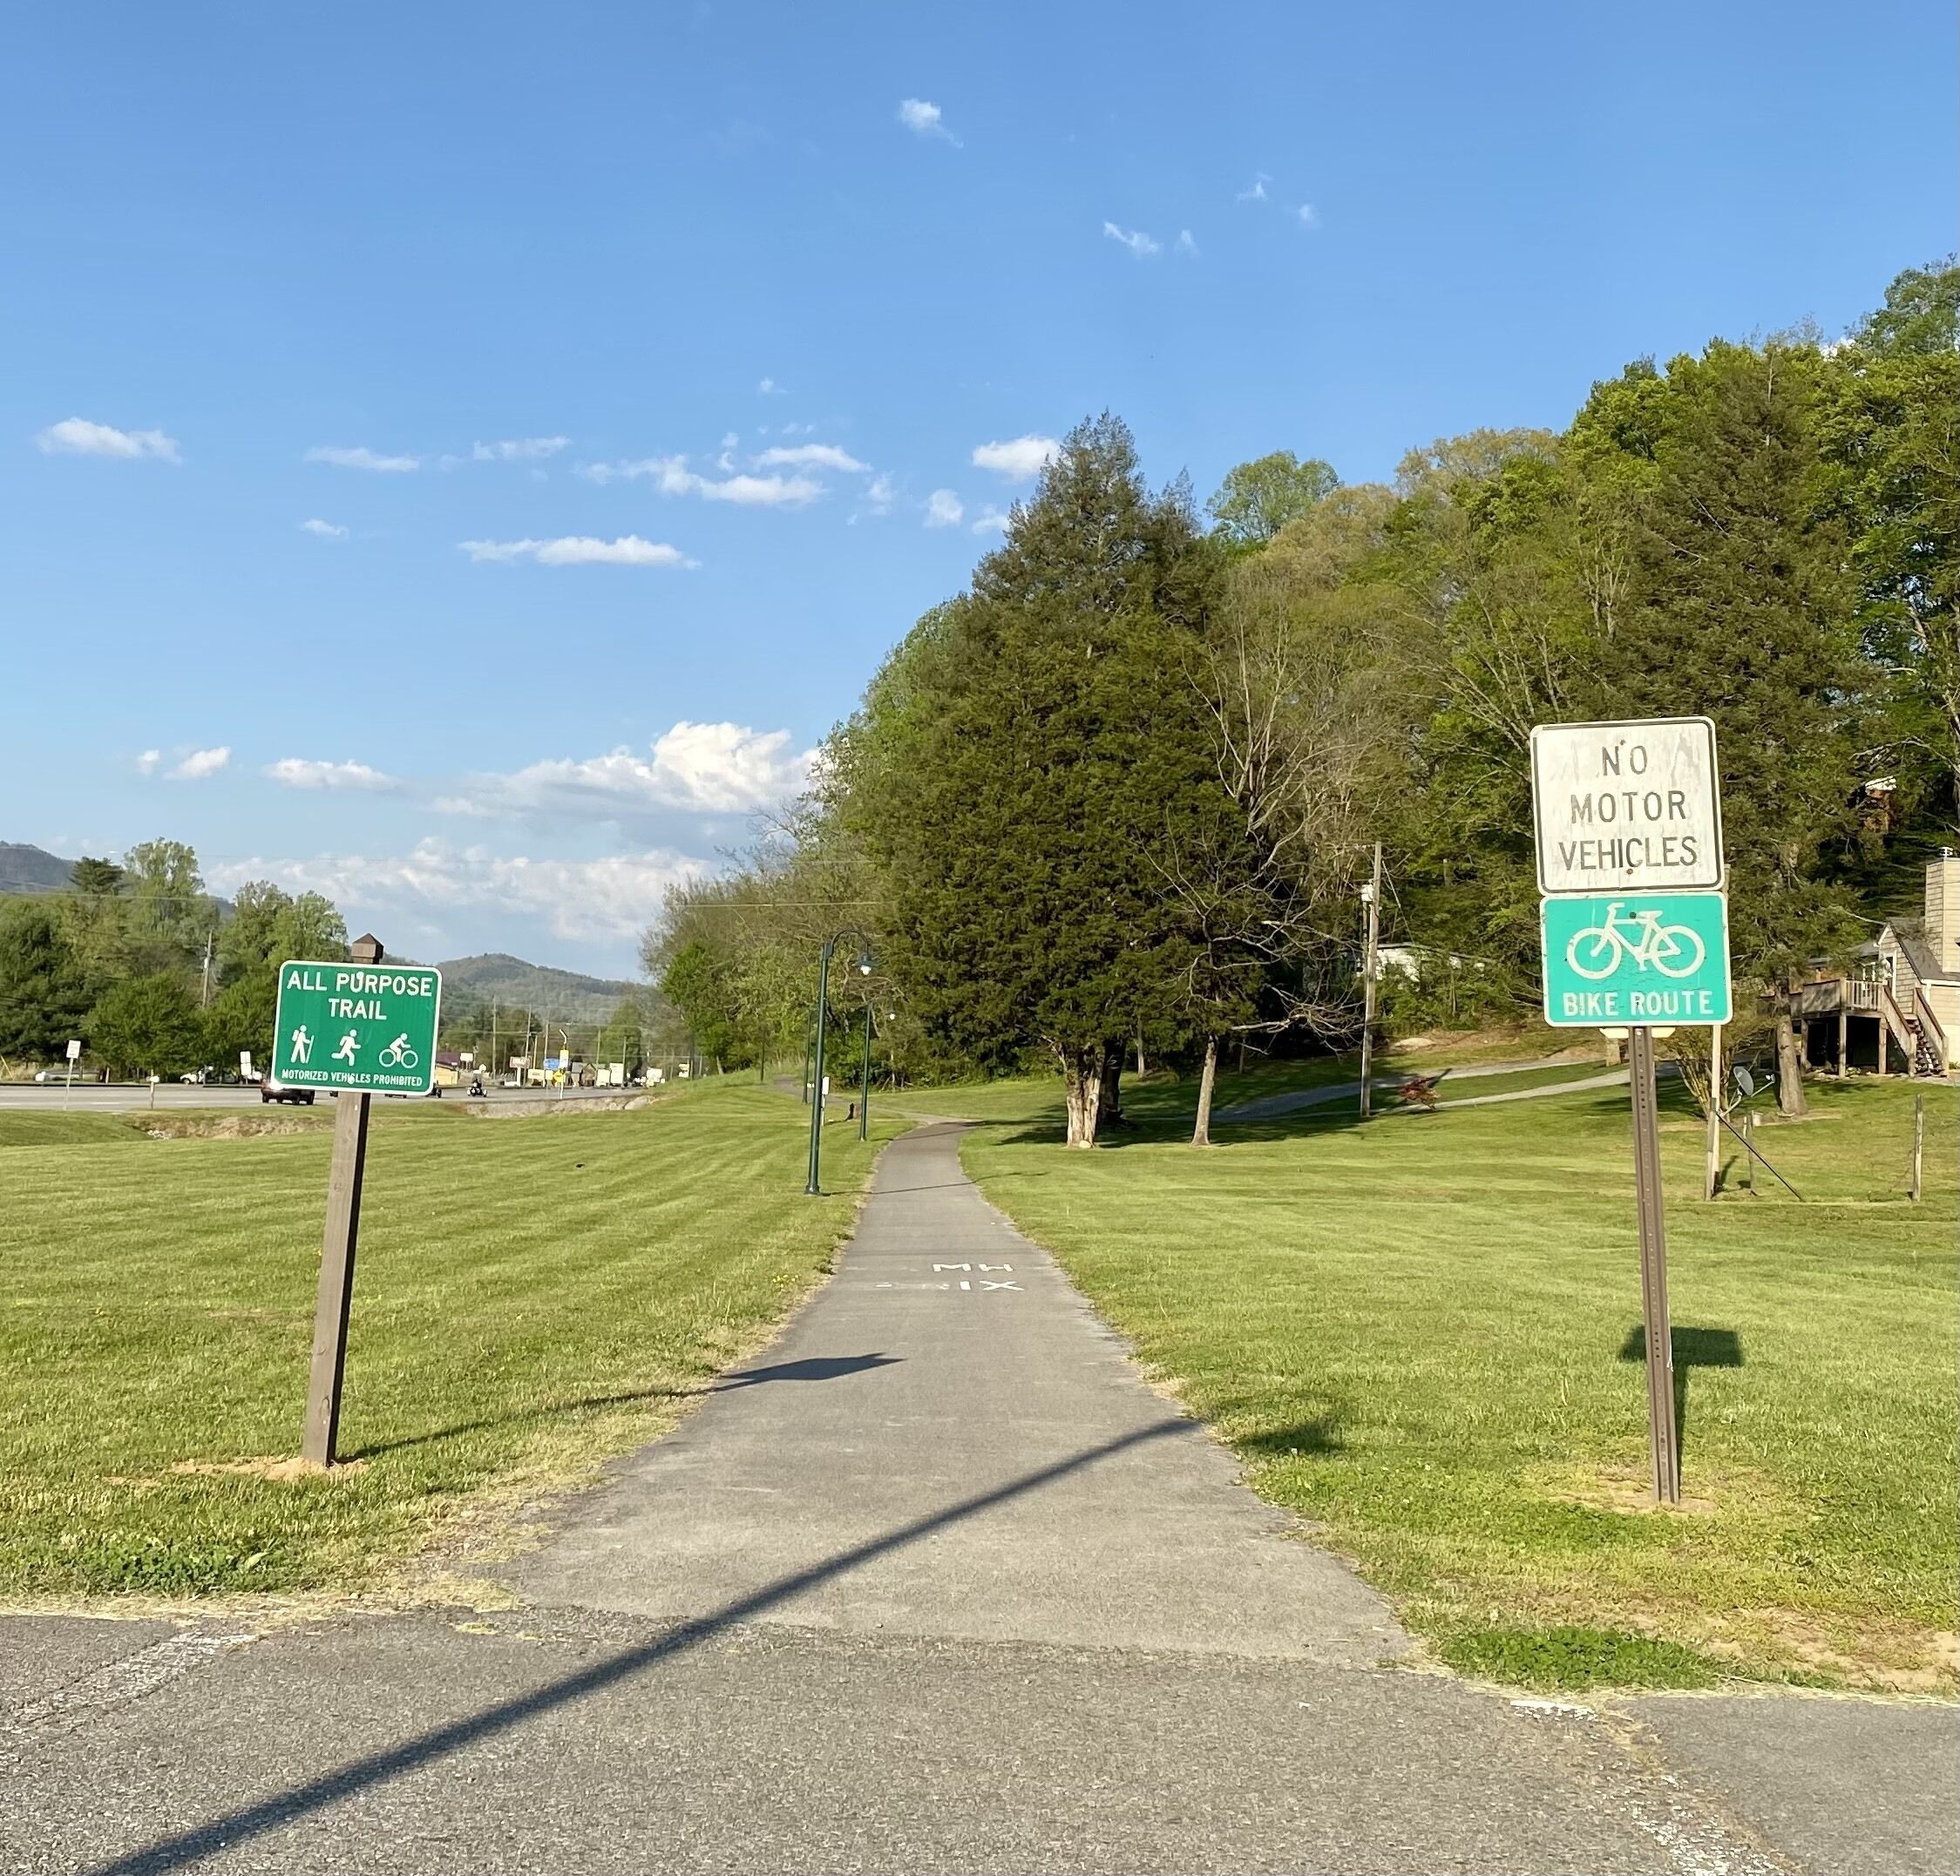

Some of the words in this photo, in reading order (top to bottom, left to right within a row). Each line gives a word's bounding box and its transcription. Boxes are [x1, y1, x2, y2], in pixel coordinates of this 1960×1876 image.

[1601, 745, 1648, 776] NO
[1570, 790, 1687, 824] MOTOR
[1558, 836, 1698, 871] VEHICLES
[286, 970, 328, 992] ALL
[336, 972, 433, 997] PURPOSE
[328, 998, 387, 1020] TRAIL
[1563, 991, 1618, 1017] BIKE
[1631, 990, 1715, 1017] ROUTE
[281, 1068, 329, 1080] MOTORIZED
[331, 1071, 371, 1084] VEHICLES
[373, 1073, 423, 1087] PROHIBITED
